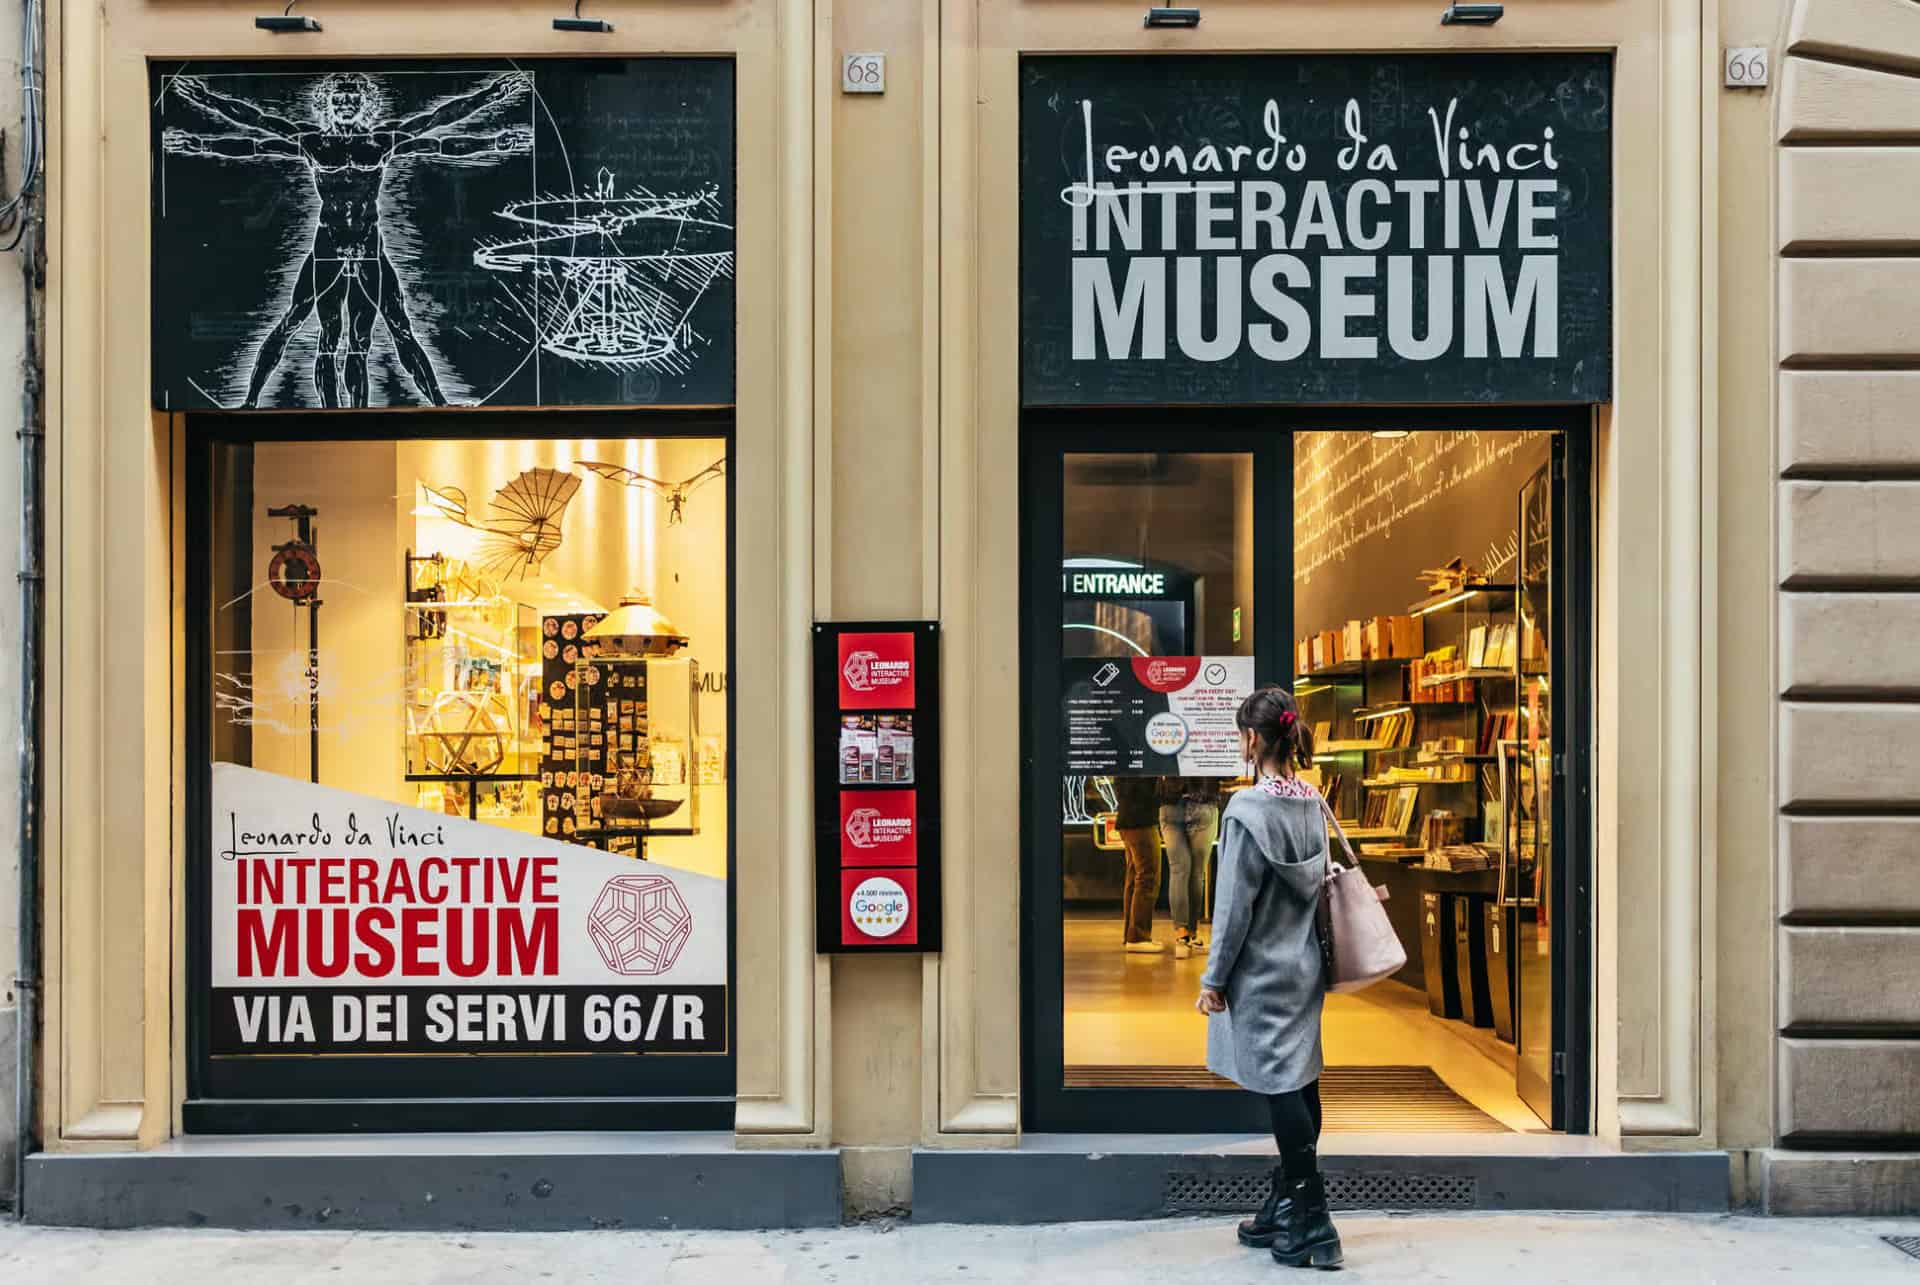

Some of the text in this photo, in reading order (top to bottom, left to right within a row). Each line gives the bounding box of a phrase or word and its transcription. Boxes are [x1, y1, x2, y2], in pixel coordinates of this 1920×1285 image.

[847, 55, 881, 84] 68
[1728, 53, 1765, 81] 66
[1061, 97, 1559, 207] Leonardo da Vinci
[1071, 178, 1560, 251] INTERACTIVE
[1071, 253, 1560, 362] MUSEUM
[1073, 573, 1164, 594] ENTRANCE
[692, 671, 727, 693] MU
[221, 812, 446, 860] Leonardo da Vinci
[872, 818, 912, 827] LEONARDO
[237, 857, 559, 905] INTERACTIVE
[855, 899, 904, 915] Google
[237, 908, 559, 978] MUSEUM
[232, 993, 705, 1043] VIA DEI SERVI 66/R
